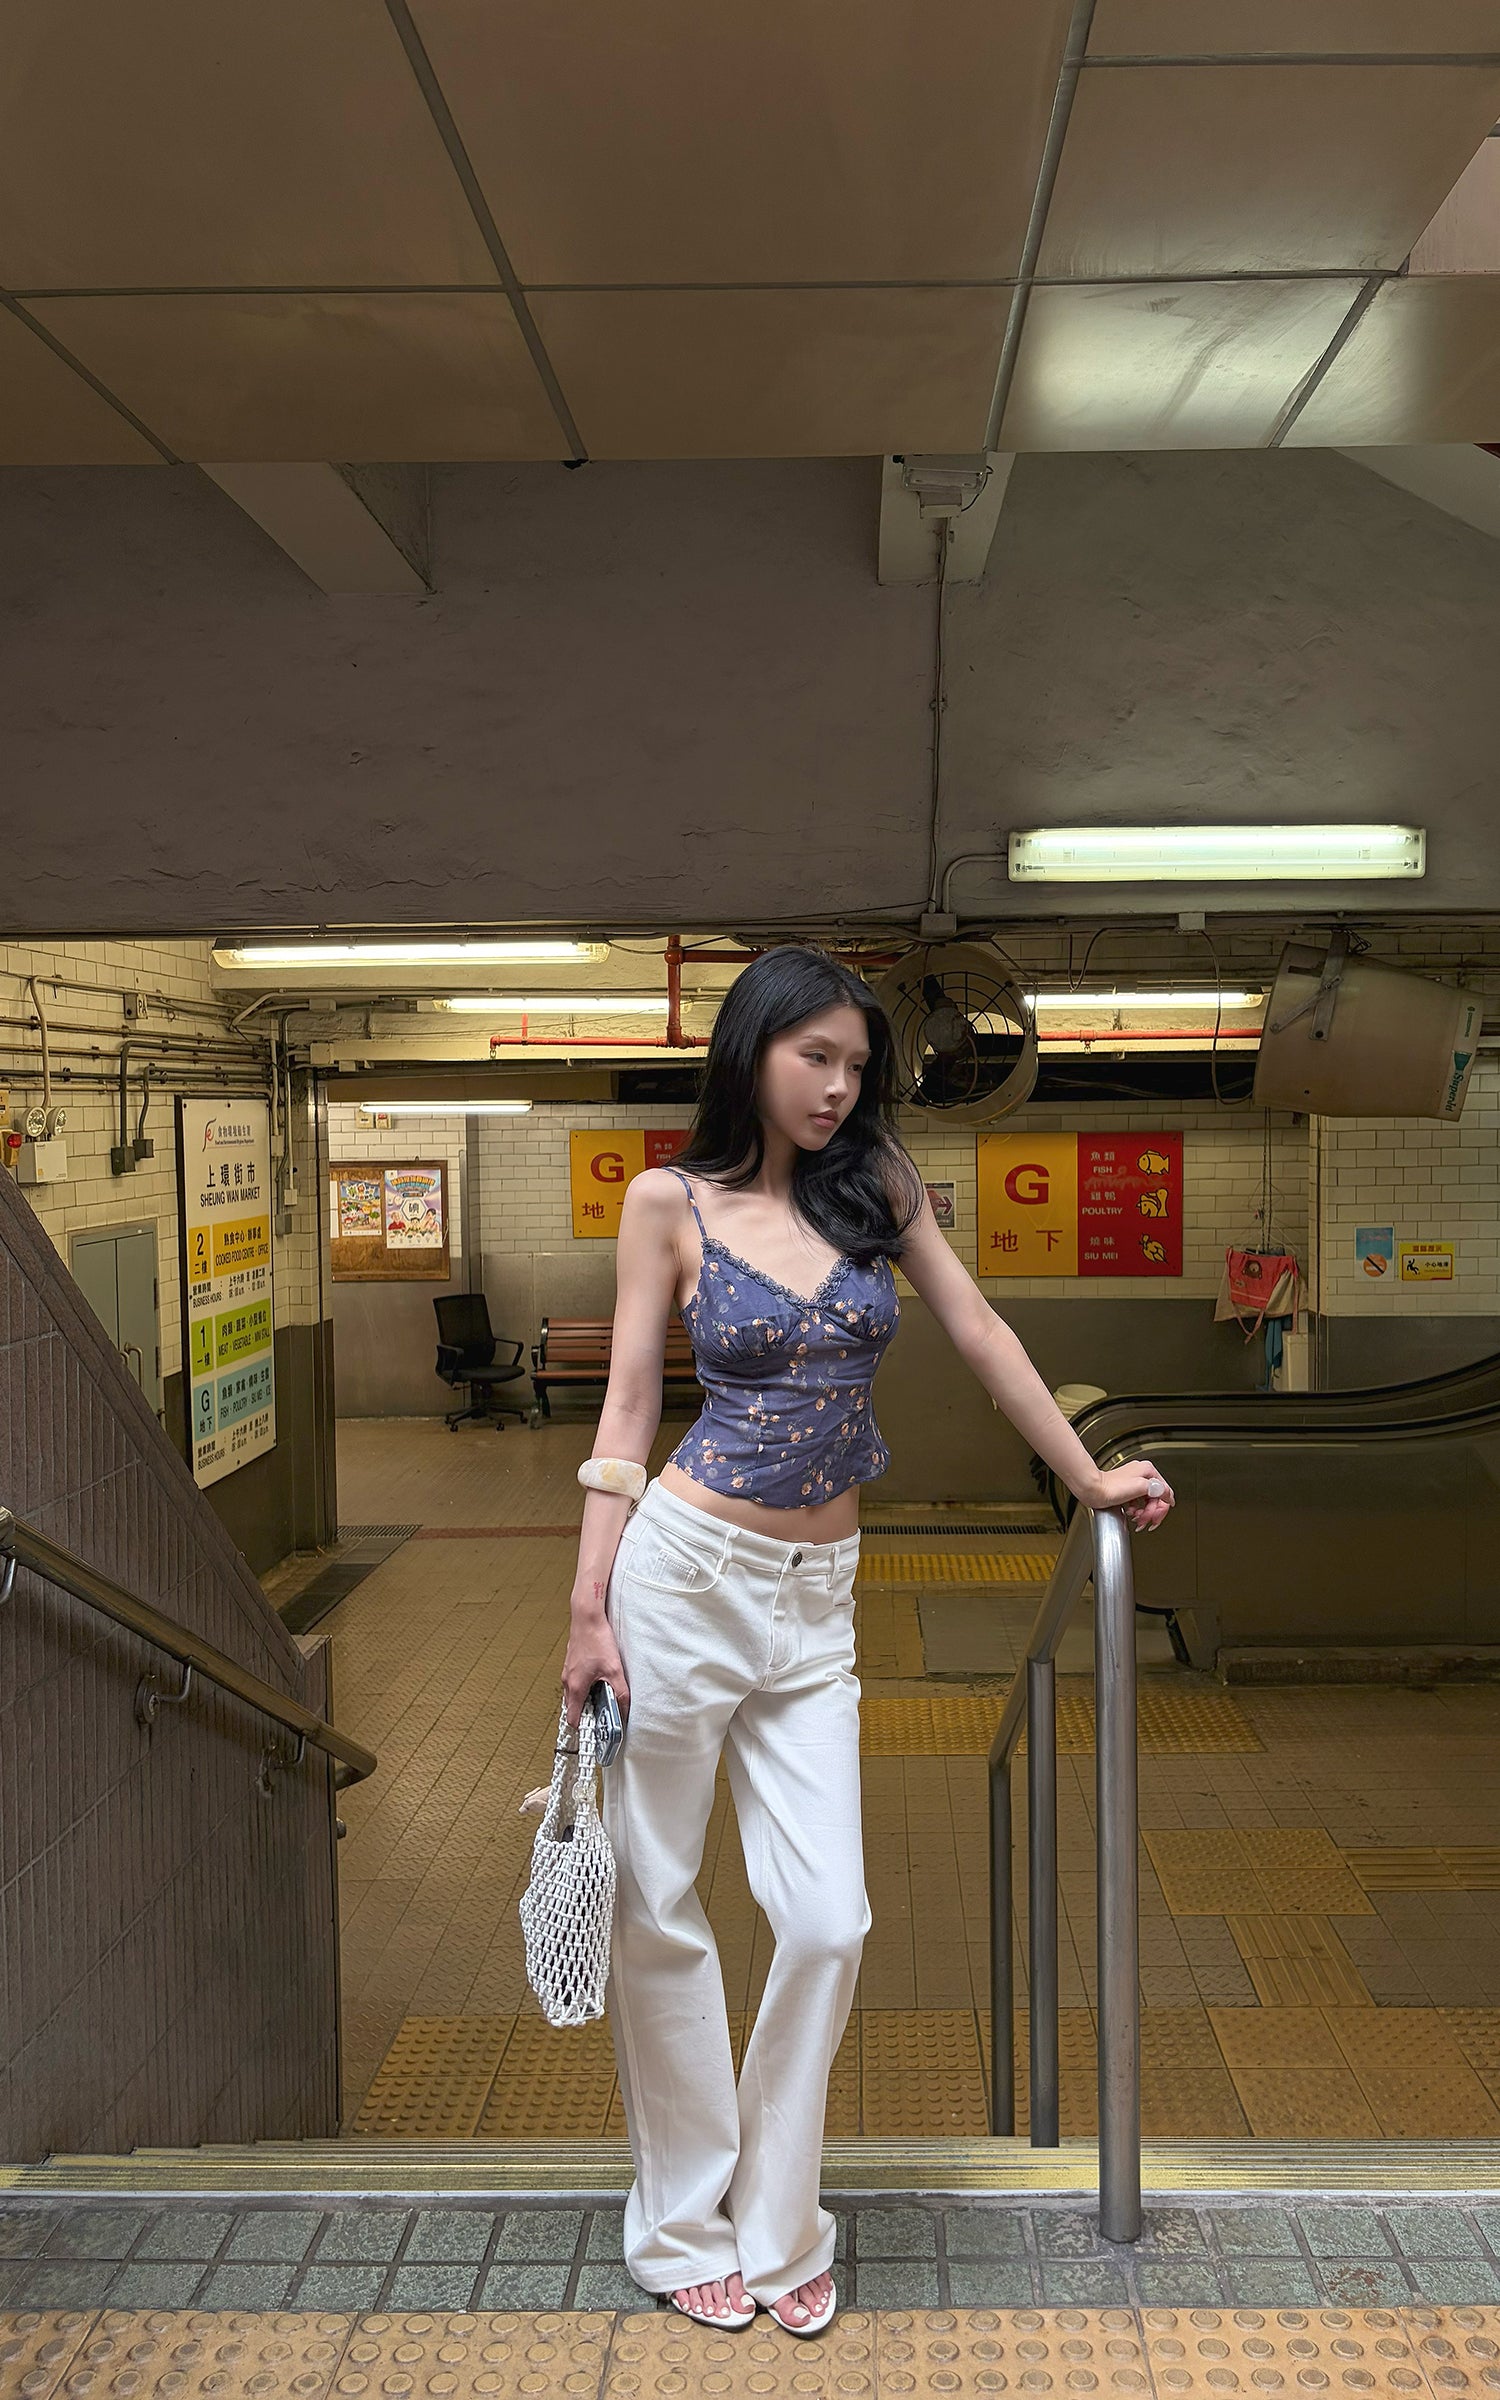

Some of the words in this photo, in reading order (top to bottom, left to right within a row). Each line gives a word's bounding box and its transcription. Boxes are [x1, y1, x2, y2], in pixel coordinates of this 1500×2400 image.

[206, 1161, 256, 1188] 上環街市
[591, 1152, 624, 1182] G
[1004, 1163, 1050, 1205] G
[200, 1191, 225, 1207] SHEUNG
[226, 1189, 240, 1203] WAN
[240, 1186, 260, 1201] MARKET
[1082, 1207, 1122, 1215] POULTRY
[197, 1233, 204, 1256] 2
[990, 1229, 1063, 1253] 地下
[1084, 1252, 1099, 1260] SIU
[1102, 1252, 1118, 1260] MEI
[200, 1325, 206, 1348] 1
[201, 1389, 210, 1413] G
[199, 1415, 213, 1433] 地下
